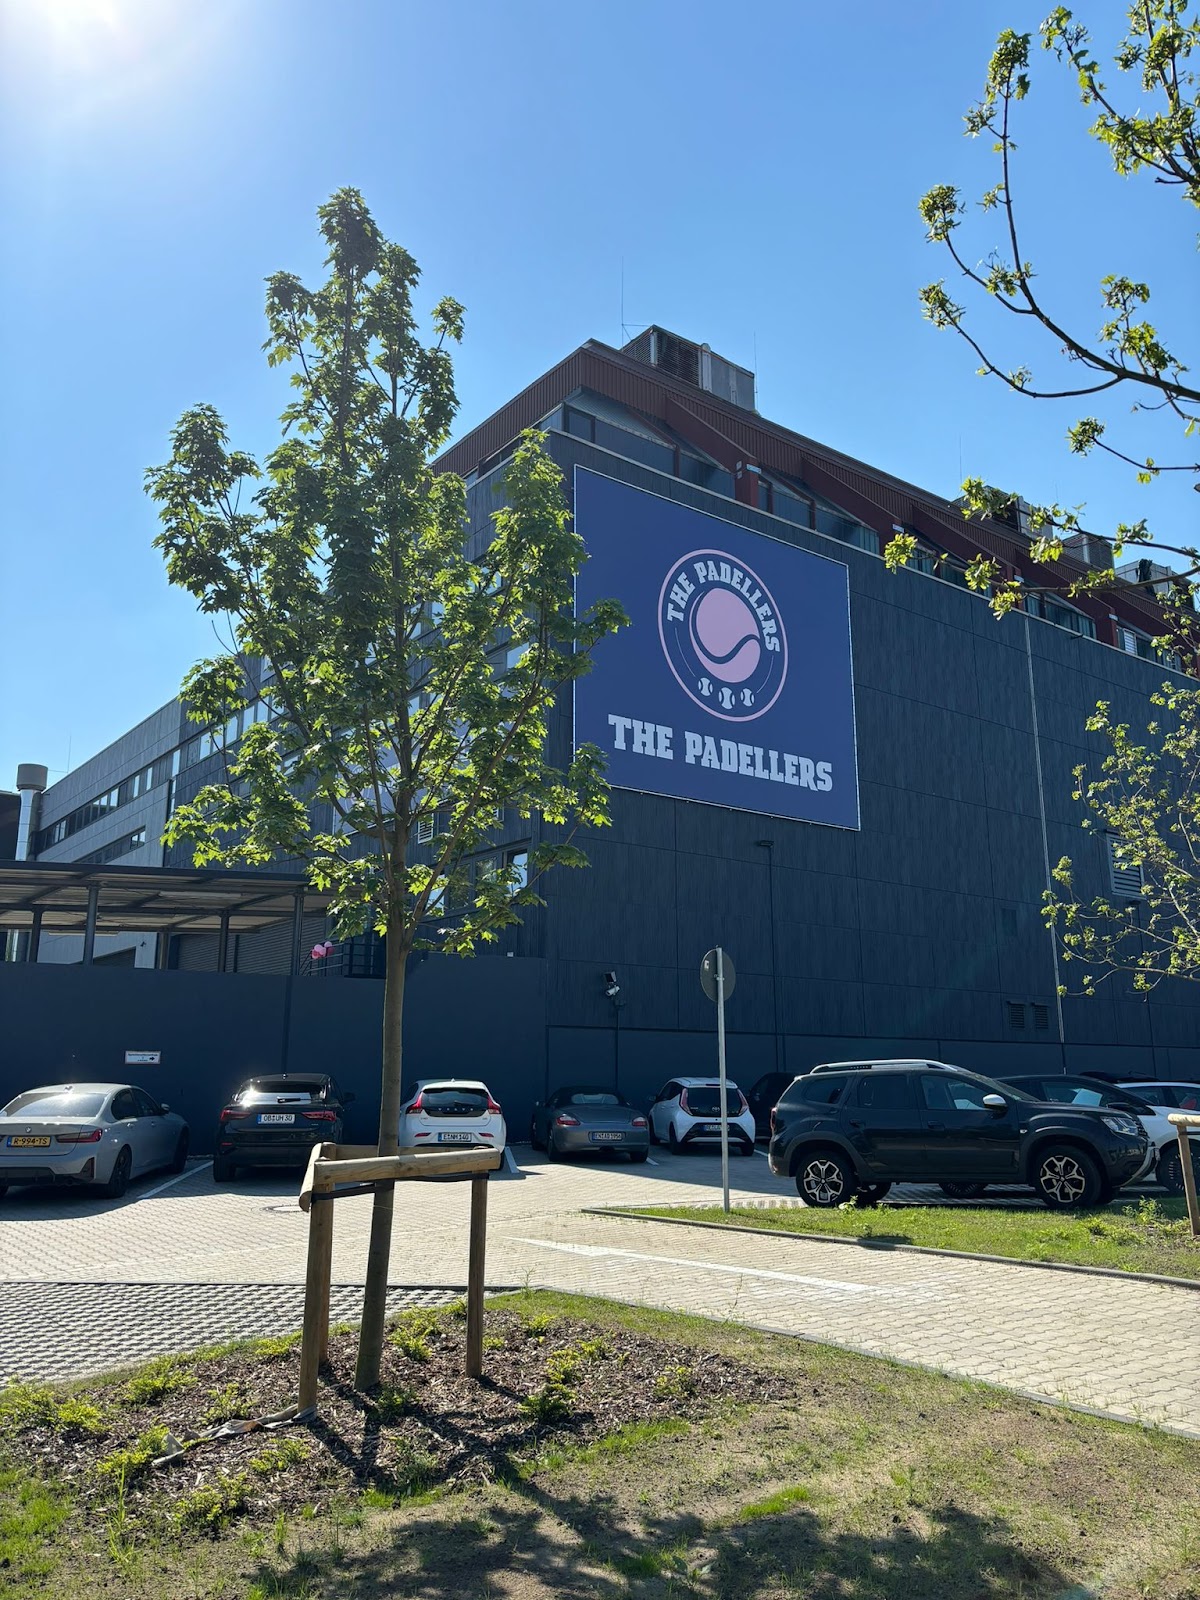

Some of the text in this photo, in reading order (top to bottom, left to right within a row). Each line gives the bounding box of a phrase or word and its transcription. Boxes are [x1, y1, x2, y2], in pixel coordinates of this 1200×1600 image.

[666, 560, 781, 653] THE PADELLERS
[608, 713, 833, 792] THE PADELLERS
